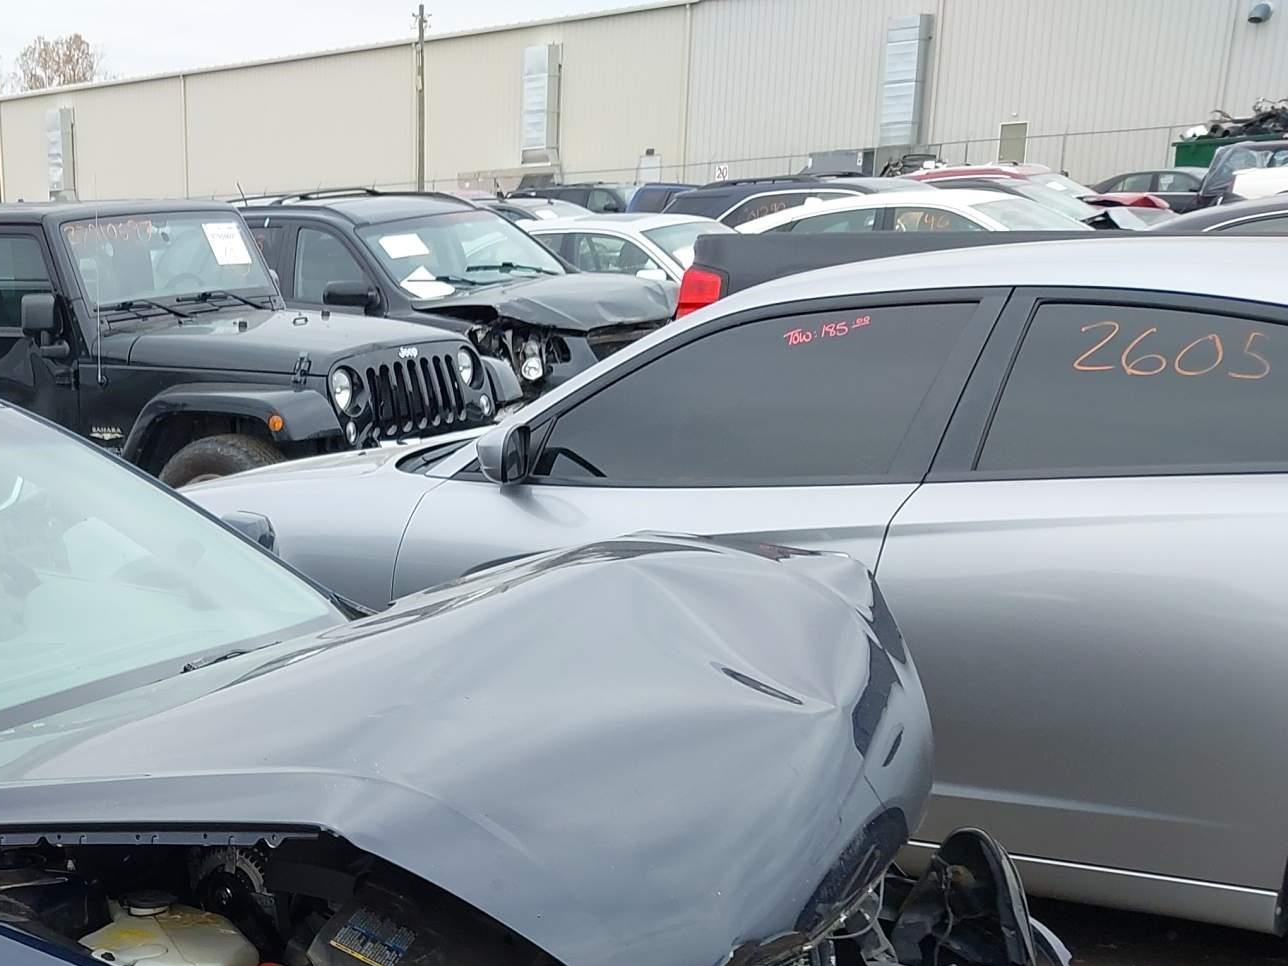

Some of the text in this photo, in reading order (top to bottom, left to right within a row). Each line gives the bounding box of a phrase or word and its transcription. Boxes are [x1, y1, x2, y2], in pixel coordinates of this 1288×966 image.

[716, 166, 728, 179] 20
[398, 346, 418, 359] Jeep
[1072, 320, 1271, 379] 2605
